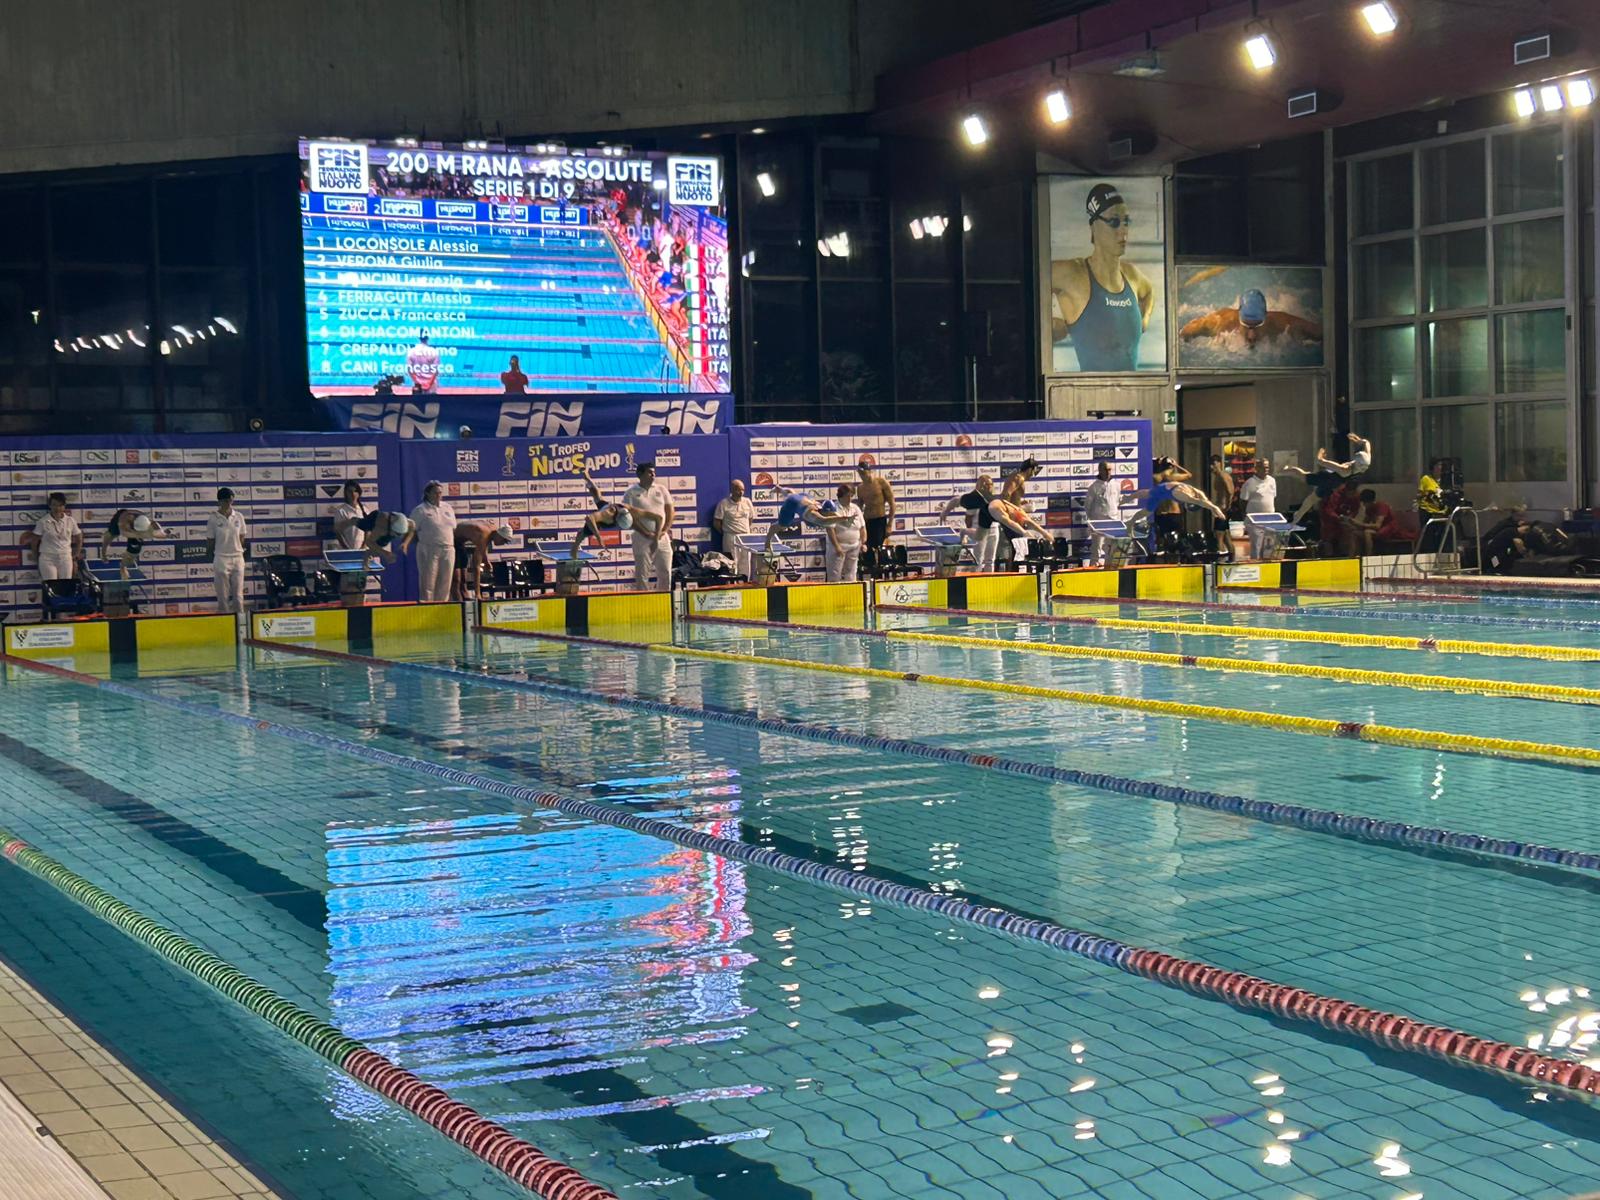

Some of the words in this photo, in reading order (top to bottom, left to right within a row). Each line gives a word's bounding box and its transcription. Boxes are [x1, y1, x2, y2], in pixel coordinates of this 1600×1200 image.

[317, 148, 361, 168] FIN
[386, 152, 429, 173] 200
[436, 154, 456, 175] M
[461, 156, 523, 178] RANA
[545, 160, 652, 182] ASSOLUTE
[675, 163, 711, 182] FIN
[319, 179, 362, 190] NUOTO
[473, 179, 523, 197] SERIE
[527, 181, 536, 199] 1
[540, 182, 560, 198] DI
[563, 183, 575, 199] 9
[676, 191, 713, 202] NUOTO
[318, 237, 325, 249] 1
[335, 238, 424, 252] LOCONSOLE
[429, 239, 479, 253] Alessia
[317, 254, 325, 266] 2
[336, 256, 396, 267] VERONA
[401, 257, 443, 268] Giulia
[317, 290, 327, 303] 4
[338, 291, 417, 304] FERRAGUTI
[421, 292, 472, 305] Alessia
[319, 309, 328, 321] 5
[339, 308, 391, 321] ZUCCA
[394, 309, 466, 323] Francesca
[339, 326, 355, 338] DI
[359, 326, 475, 339] GIACOMANTONI
[708, 328, 728, 341] ITA
[321, 344, 329, 356] 7
[708, 344, 729, 357] ITA
[321, 361, 330, 373] 8
[341, 361, 378, 373] CANI
[381, 361, 454, 374] Francesca
[708, 361, 729, 373] ITA
[350, 401, 440, 439] FIN
[496, 401, 585, 438] FIN
[635, 400, 720, 435] FIN
[456, 450, 479, 461] FIN
[548, 442, 590, 456] TROFEO
